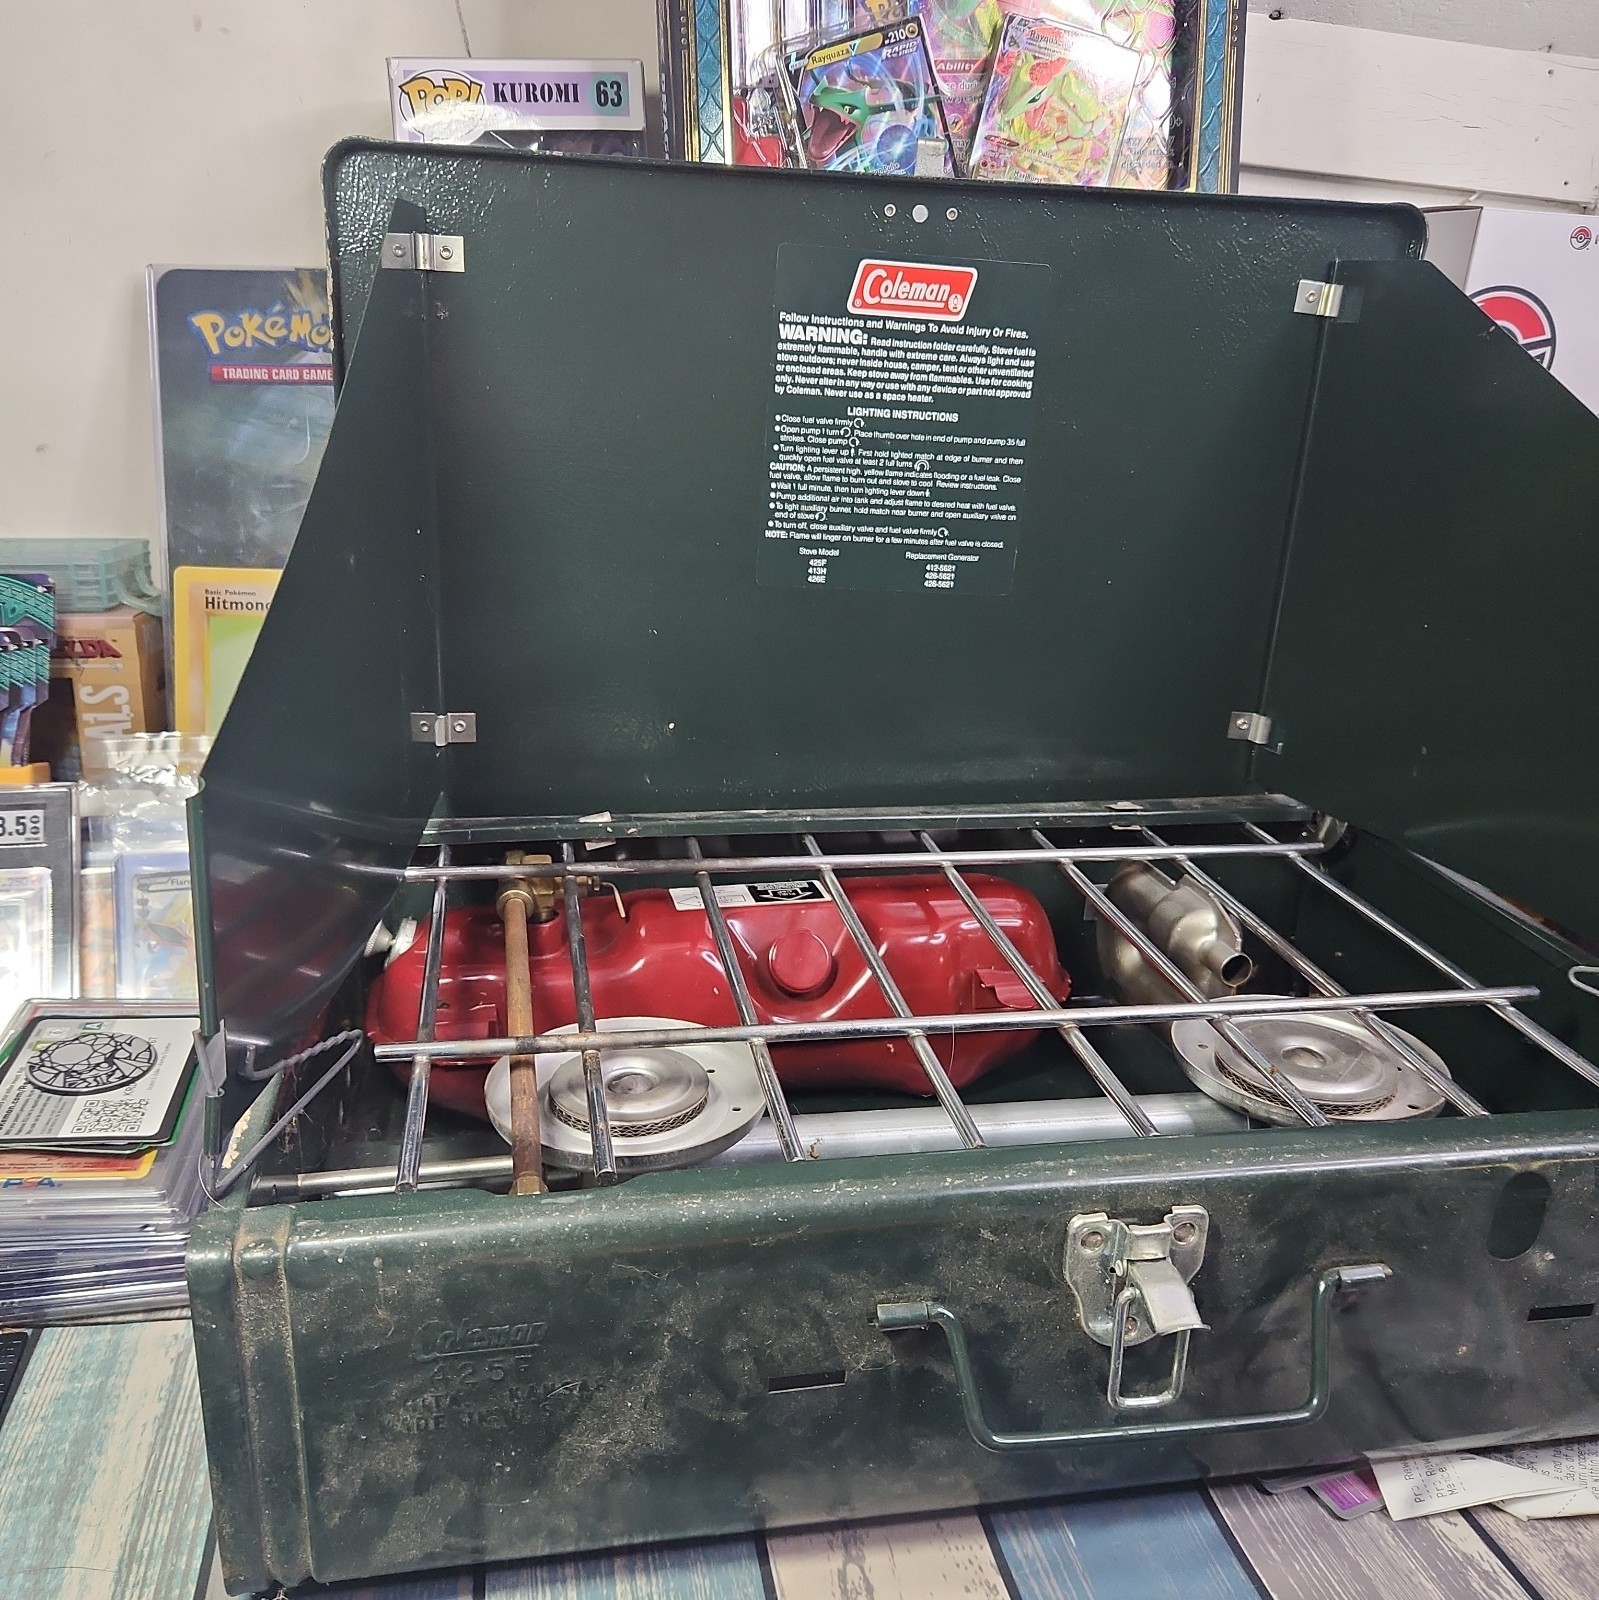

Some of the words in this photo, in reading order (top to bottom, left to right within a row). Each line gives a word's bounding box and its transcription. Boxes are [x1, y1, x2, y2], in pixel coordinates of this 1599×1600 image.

[811, 48, 849, 65] Rayquaza
[888, 29, 906, 44] 210
[936, 62, 976, 71] Ability
[492, 82, 580, 103] KUROMI
[595, 80, 623, 108] 63
[863, 268, 951, 305] Coleman
[191, 300, 331, 355] Pokémo
[780, 313, 809, 324] Follow
[811, 315, 864, 327] Instructions
[867, 319, 883, 329] and
[886, 320, 926, 334] Warnings
[929, 323, 938, 332] To
[941, 324, 965, 334] Avoid
[966, 326, 991, 338] Injury
[993, 328, 1003, 337] Or
[1005, 328, 1028, 338] Fires.
[779, 325, 869, 346] WARNING:
[871, 338, 891, 347] Read
[892, 339, 932, 350] instruction
[933, 342, 955, 351] folder
[956, 343, 990, 355] carefully.
[992, 346, 1013, 355] Stove
[1014, 347, 1029, 356] fuel
[1029, 348, 1036, 356] is
[777, 342, 816, 355] extremely
[818, 345, 859, 357] flammable,
[862, 347, 887, 358] handle
[889, 349, 905, 359] with
[907, 350, 938, 361] extreme
[939, 354, 957, 362] care.
[960, 354, 986, 366] Always
[987, 355, 1004, 367] light
[1005, 357, 1020, 366] and
[1021, 359, 1035, 367] use
[777, 353, 798, 363] stove
[799, 354, 835, 367] outdoors;
[837, 358, 858, 367] never
[860, 358, 883, 368] inside
[884, 360, 909, 371] house,
[911, 363, 941, 374] camper,
[943, 363, 957, 373] tent
[968, 365, 987, 375] other
[988, 366, 1034, 378] unventilated
[223, 368, 269, 380] TRADING
[272, 368, 299, 380] CARD
[303, 368, 333, 381] GAME
[786, 364, 821, 375] enclosed
[847, 368, 867, 380] Keep
[869, 370, 889, 379] stove
[890, 373, 909, 382] away
[910, 372, 928, 381] from
[929, 373, 973, 384] flammables.
[976, 376, 990, 385] Use
[991, 377, 1002, 386] for
[1003, 378, 1032, 390] cooking
[774, 386, 784, 396] by
[786, 386, 822, 396] Coleman.
[824, 389, 847, 398] Never
[883, 394, 906, 403] space
[908, 394, 934, 403] heater.
[775, 375, 793, 386] only.
[795, 376, 818, 386] Never
[819, 377, 836, 387] alter
[837, 379, 844, 387] in
[846, 381, 859, 390] any
[861, 382, 875, 391] way
[901, 382, 916, 391] with
[917, 385, 931, 394] any
[932, 384, 957, 394] device
[967, 386, 982, 397] part
[983, 387, 995, 396] not
[996, 388, 1031, 400] approved
[781, 415, 801, 423] Close
[803, 416, 815, 424] fuel
[816, 417, 833, 425] valve
[835, 418, 853, 428] firmly
[847, 406, 891, 418] LIGHTING
[893, 409, 959, 422] INSTRUCTIONS
[799, 547, 817, 555] Stove
[819, 548, 840, 556] Model
[905, 551, 947, 562] Replacement
[948, 553, 980, 562] Generator
[807, 567, 827, 575] 413H
[809, 559, 827, 567] 425F
[3, 1177, 56, 1189] PSA
[412, 1317, 548, 1363] Coleman
[1563, 1453, 1575, 1462] of
[1563, 1465, 1575, 1481] days
